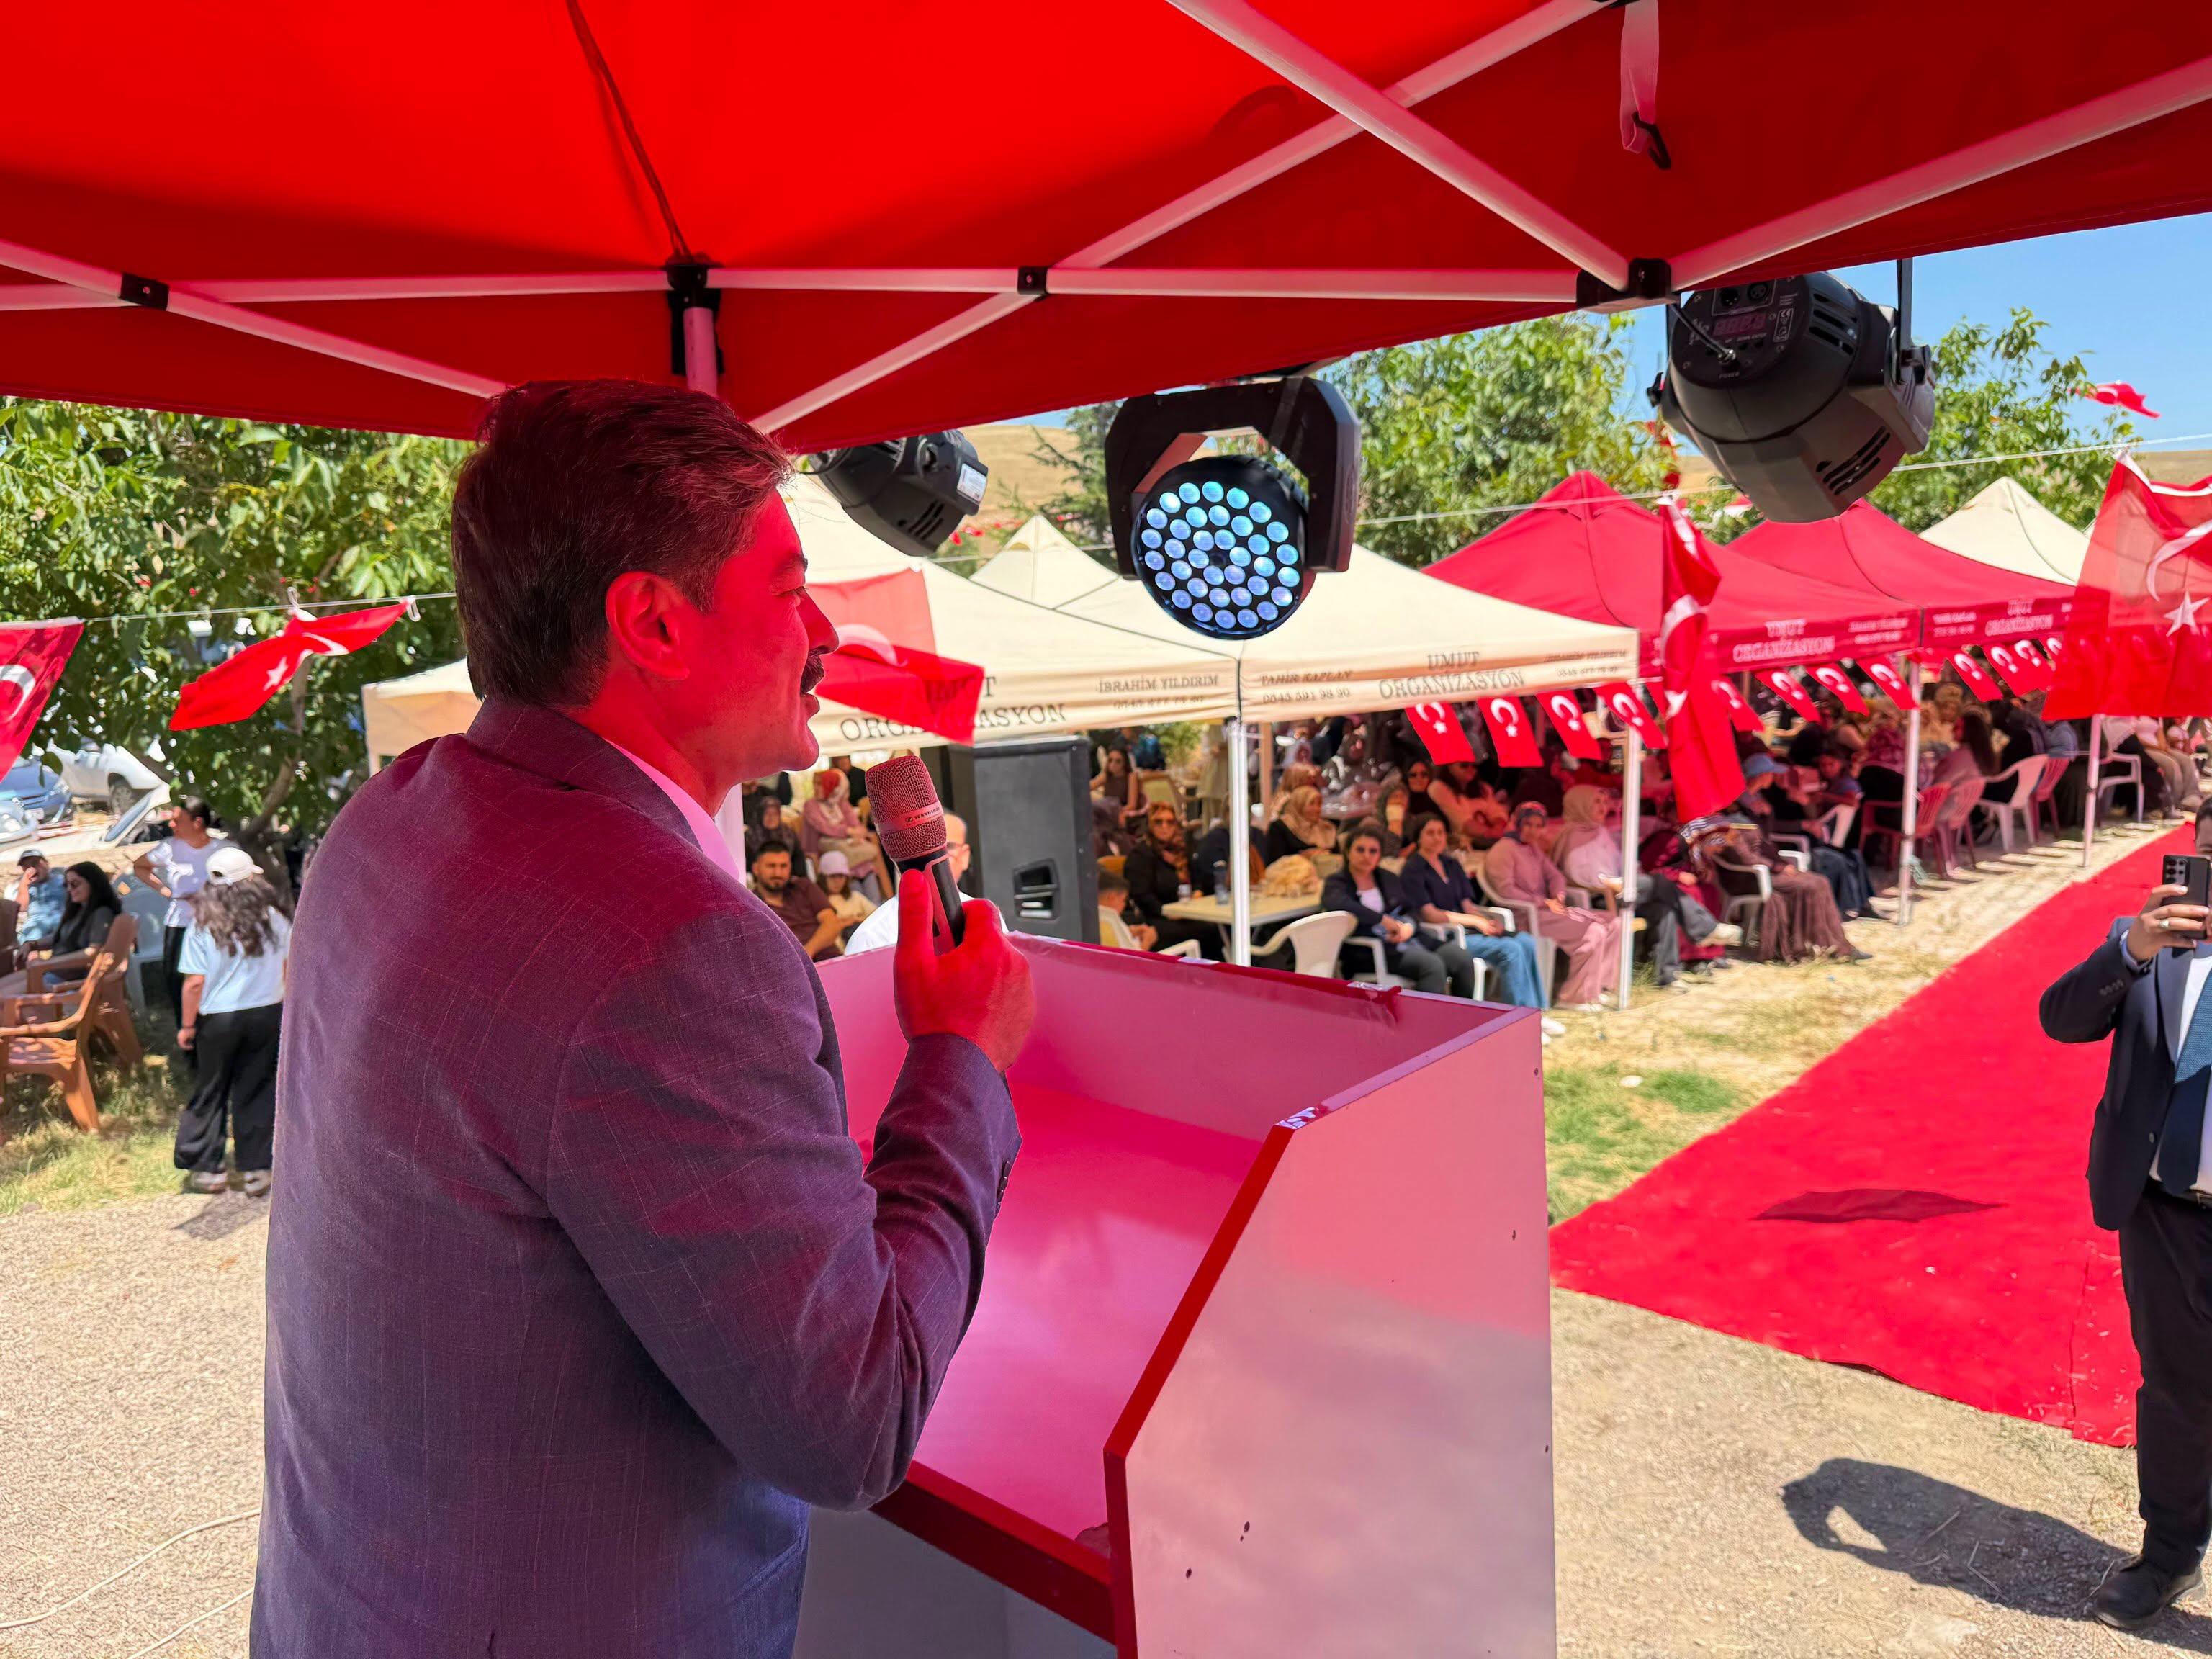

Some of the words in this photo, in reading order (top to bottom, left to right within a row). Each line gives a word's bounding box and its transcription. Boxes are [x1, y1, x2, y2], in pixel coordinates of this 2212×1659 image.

[1427, 651, 1480, 670] UMUT
[1100, 674, 1156, 693] İBRAHİM
[1160, 674, 1218, 690] YILDIRIM
[841, 703, 1066, 741] ORGASYON
